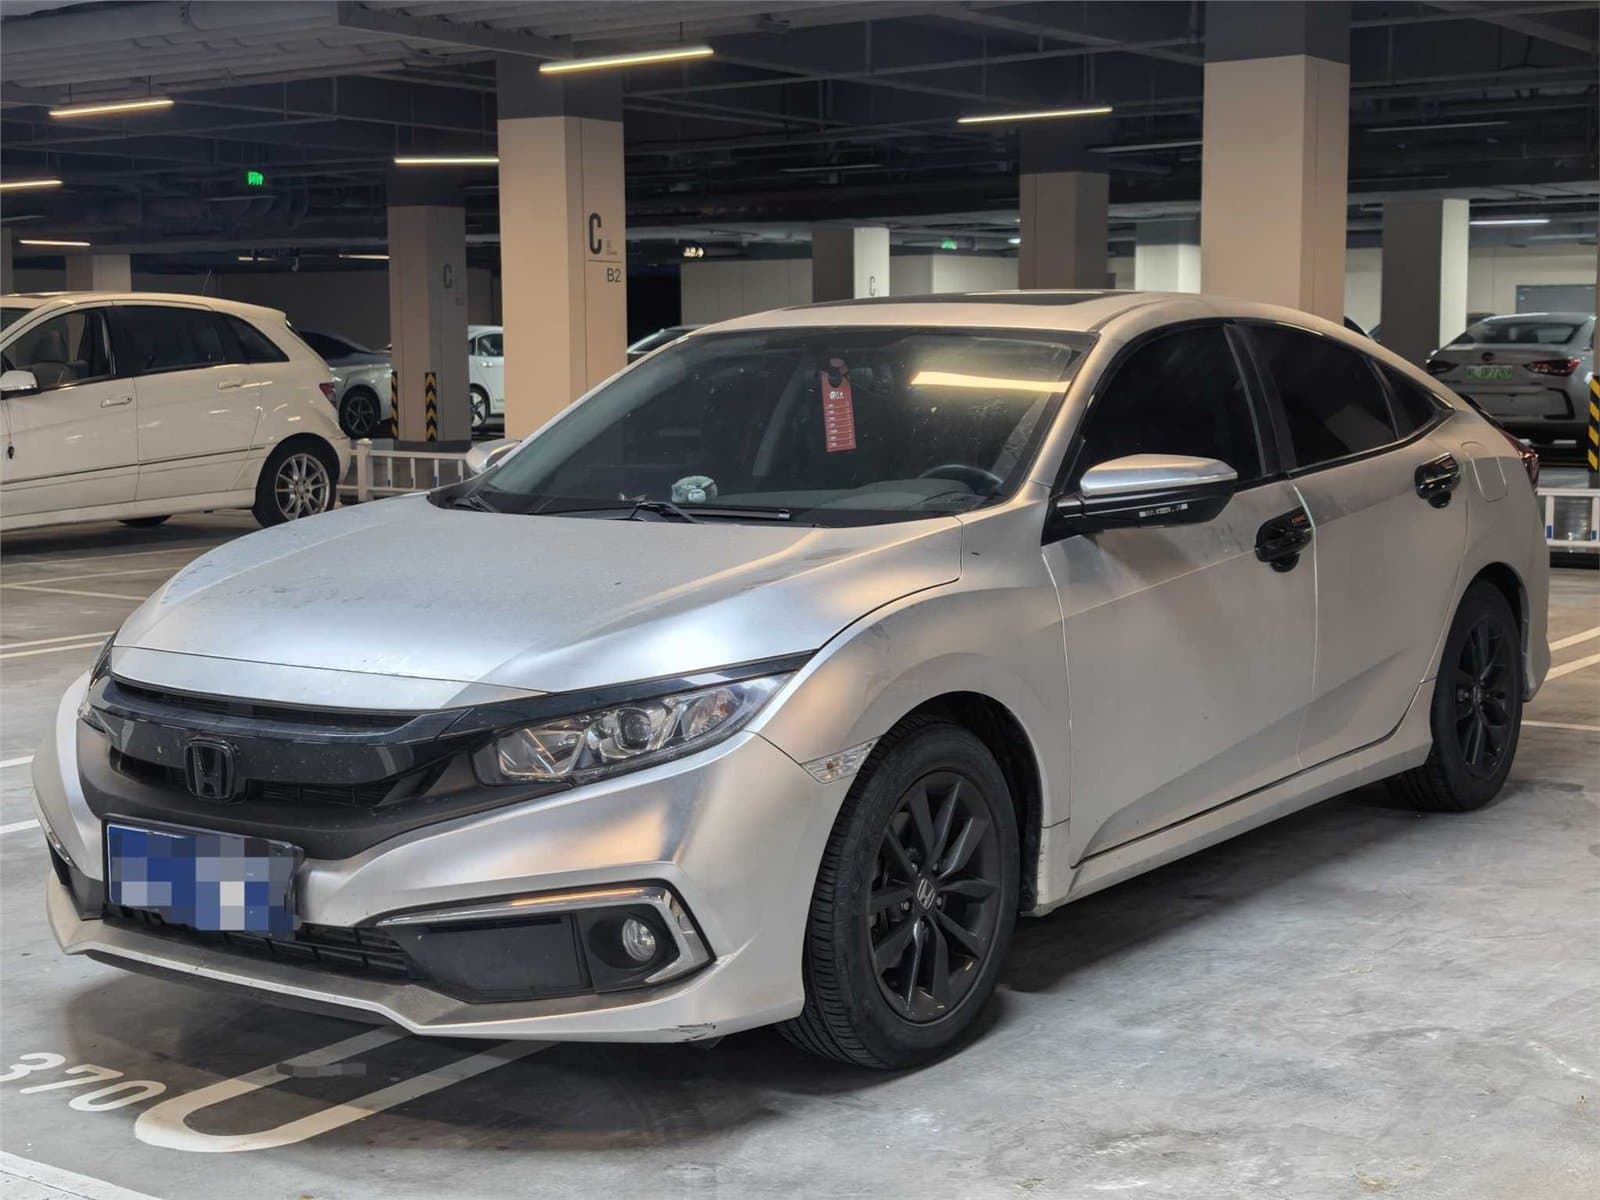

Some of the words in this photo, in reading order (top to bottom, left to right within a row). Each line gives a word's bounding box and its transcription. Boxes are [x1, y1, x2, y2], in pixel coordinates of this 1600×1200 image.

[589, 212, 602, 255] C
[443, 264, 453, 289] C
[607, 268, 622, 283] B2
[0, 1052, 167, 1112] 370
